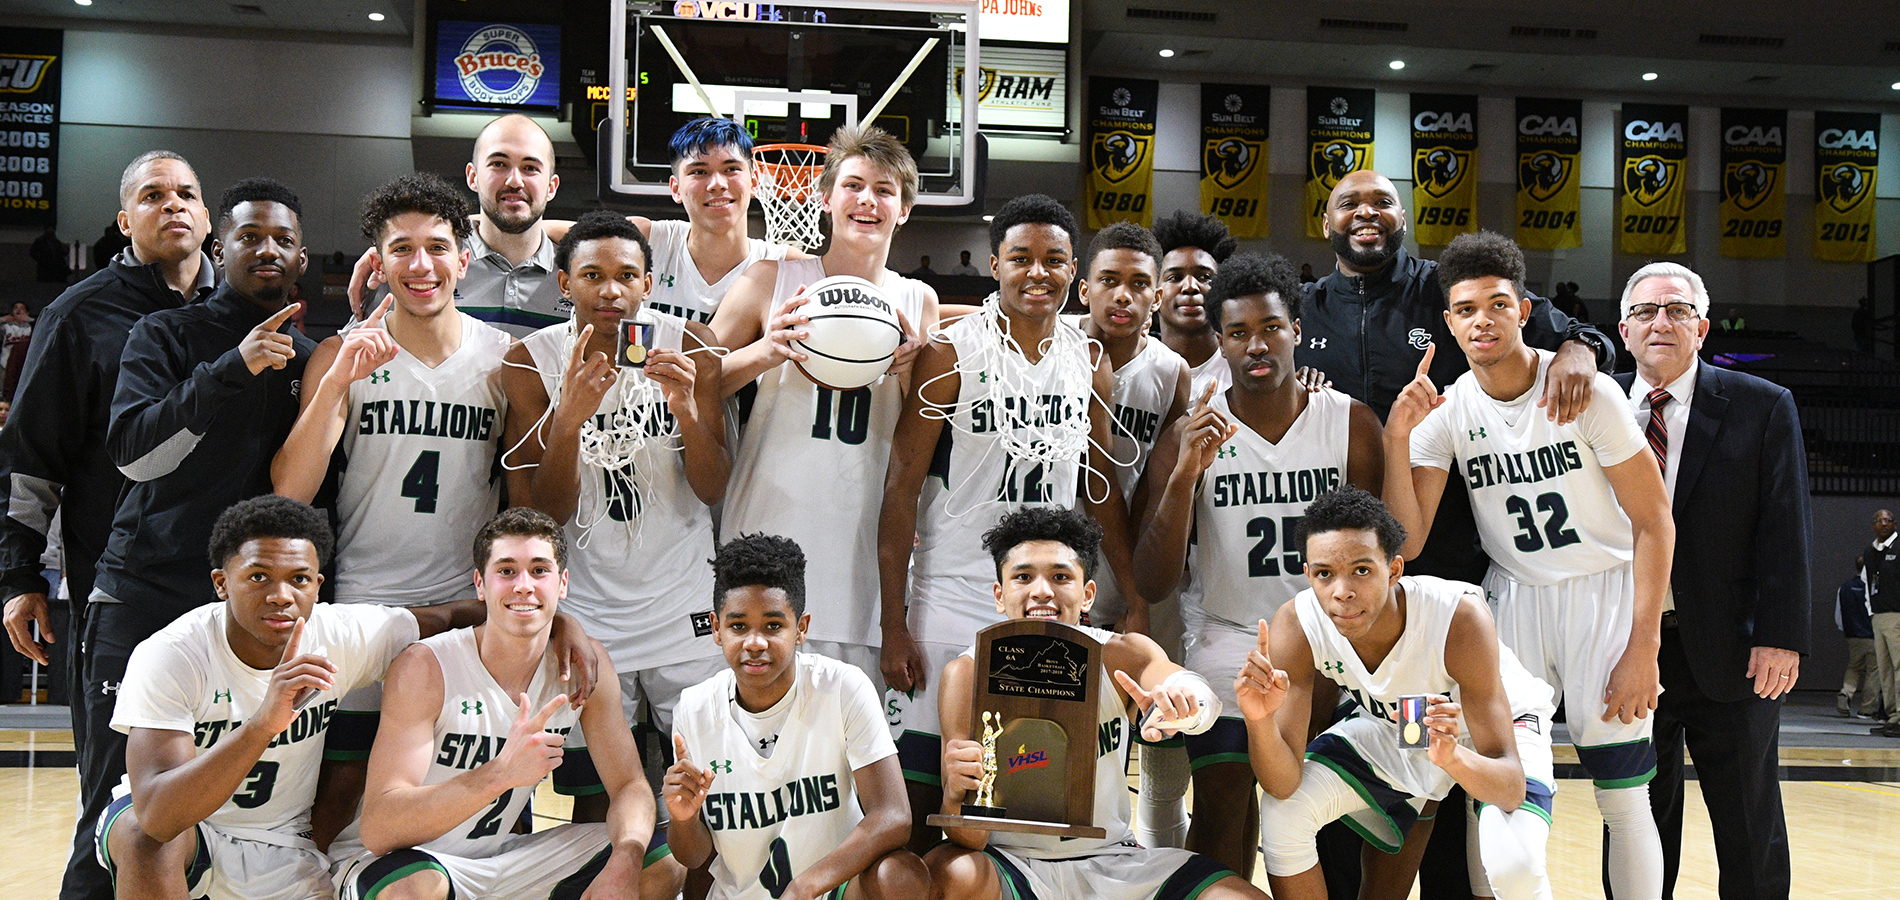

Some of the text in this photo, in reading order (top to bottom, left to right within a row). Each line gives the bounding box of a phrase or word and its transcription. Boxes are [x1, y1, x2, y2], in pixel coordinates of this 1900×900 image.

[700, 1, 757, 21] VCU
[979, 0, 999, 13] PA
[482, 29, 521, 42] SUPER
[0, 59, 46, 89] CU
[457, 52, 543, 76] Bruce's
[468, 80, 494, 103] BODY
[995, 75, 1056, 100] RAM
[0, 102, 54, 114] EASON
[1100, 106, 1145, 118] SUN BELT
[1212, 113, 1256, 124] SUN BELT
[1092, 119, 1153, 131] CHAMPIONS
[1204, 126, 1265, 136] CHAMPIONS
[1318, 116, 1362, 126] SUN BELT
[1413, 110, 1474, 133] CAA
[1519, 114, 1578, 137] CAA
[1624, 119, 1684, 142] CAA
[0, 130, 50, 148] 2005
[1310, 129, 1371, 140] CHAMPIONS
[1414, 131, 1474, 141] CHAMPIONS
[1518, 135, 1578, 145] CHAMPIONS
[1624, 140, 1684, 150] CHAMPIONS
[1725, 125, 1783, 147] CAA
[1818, 128, 1877, 150] CAA
[1724, 145, 1783, 154] CHAMPIONS
[1818, 149, 1877, 158] CHAMPIONS
[1093, 190, 1147, 213] 1980
[1210, 197, 1259, 218] 1981
[1417, 206, 1471, 226] 1996
[1521, 209, 1578, 230] 2004
[1624, 214, 1680, 234] 2007
[1723, 219, 1783, 238] 2009
[1820, 222, 1870, 242] 2012
[818, 288, 892, 316] Wilson
[359, 399, 496, 441] STALLIONS
[811, 384, 872, 445] 10
[1466, 440, 1583, 490] STALLIONS
[400, 449, 440, 514] 4
[603, 457, 642, 522] 5
[1214, 467, 1340, 507] STALLIONS
[1505, 491, 1582, 553] 32
[1246, 516, 1305, 577] 25
[998, 645, 1025, 654] CLASS
[1027, 685, 1076, 697] CHAMPIONS
[194, 698, 338, 749] STONS
[1008, 750, 1048, 768] VHSL
[232, 760, 280, 809] 3
[466, 788, 514, 840] 2
